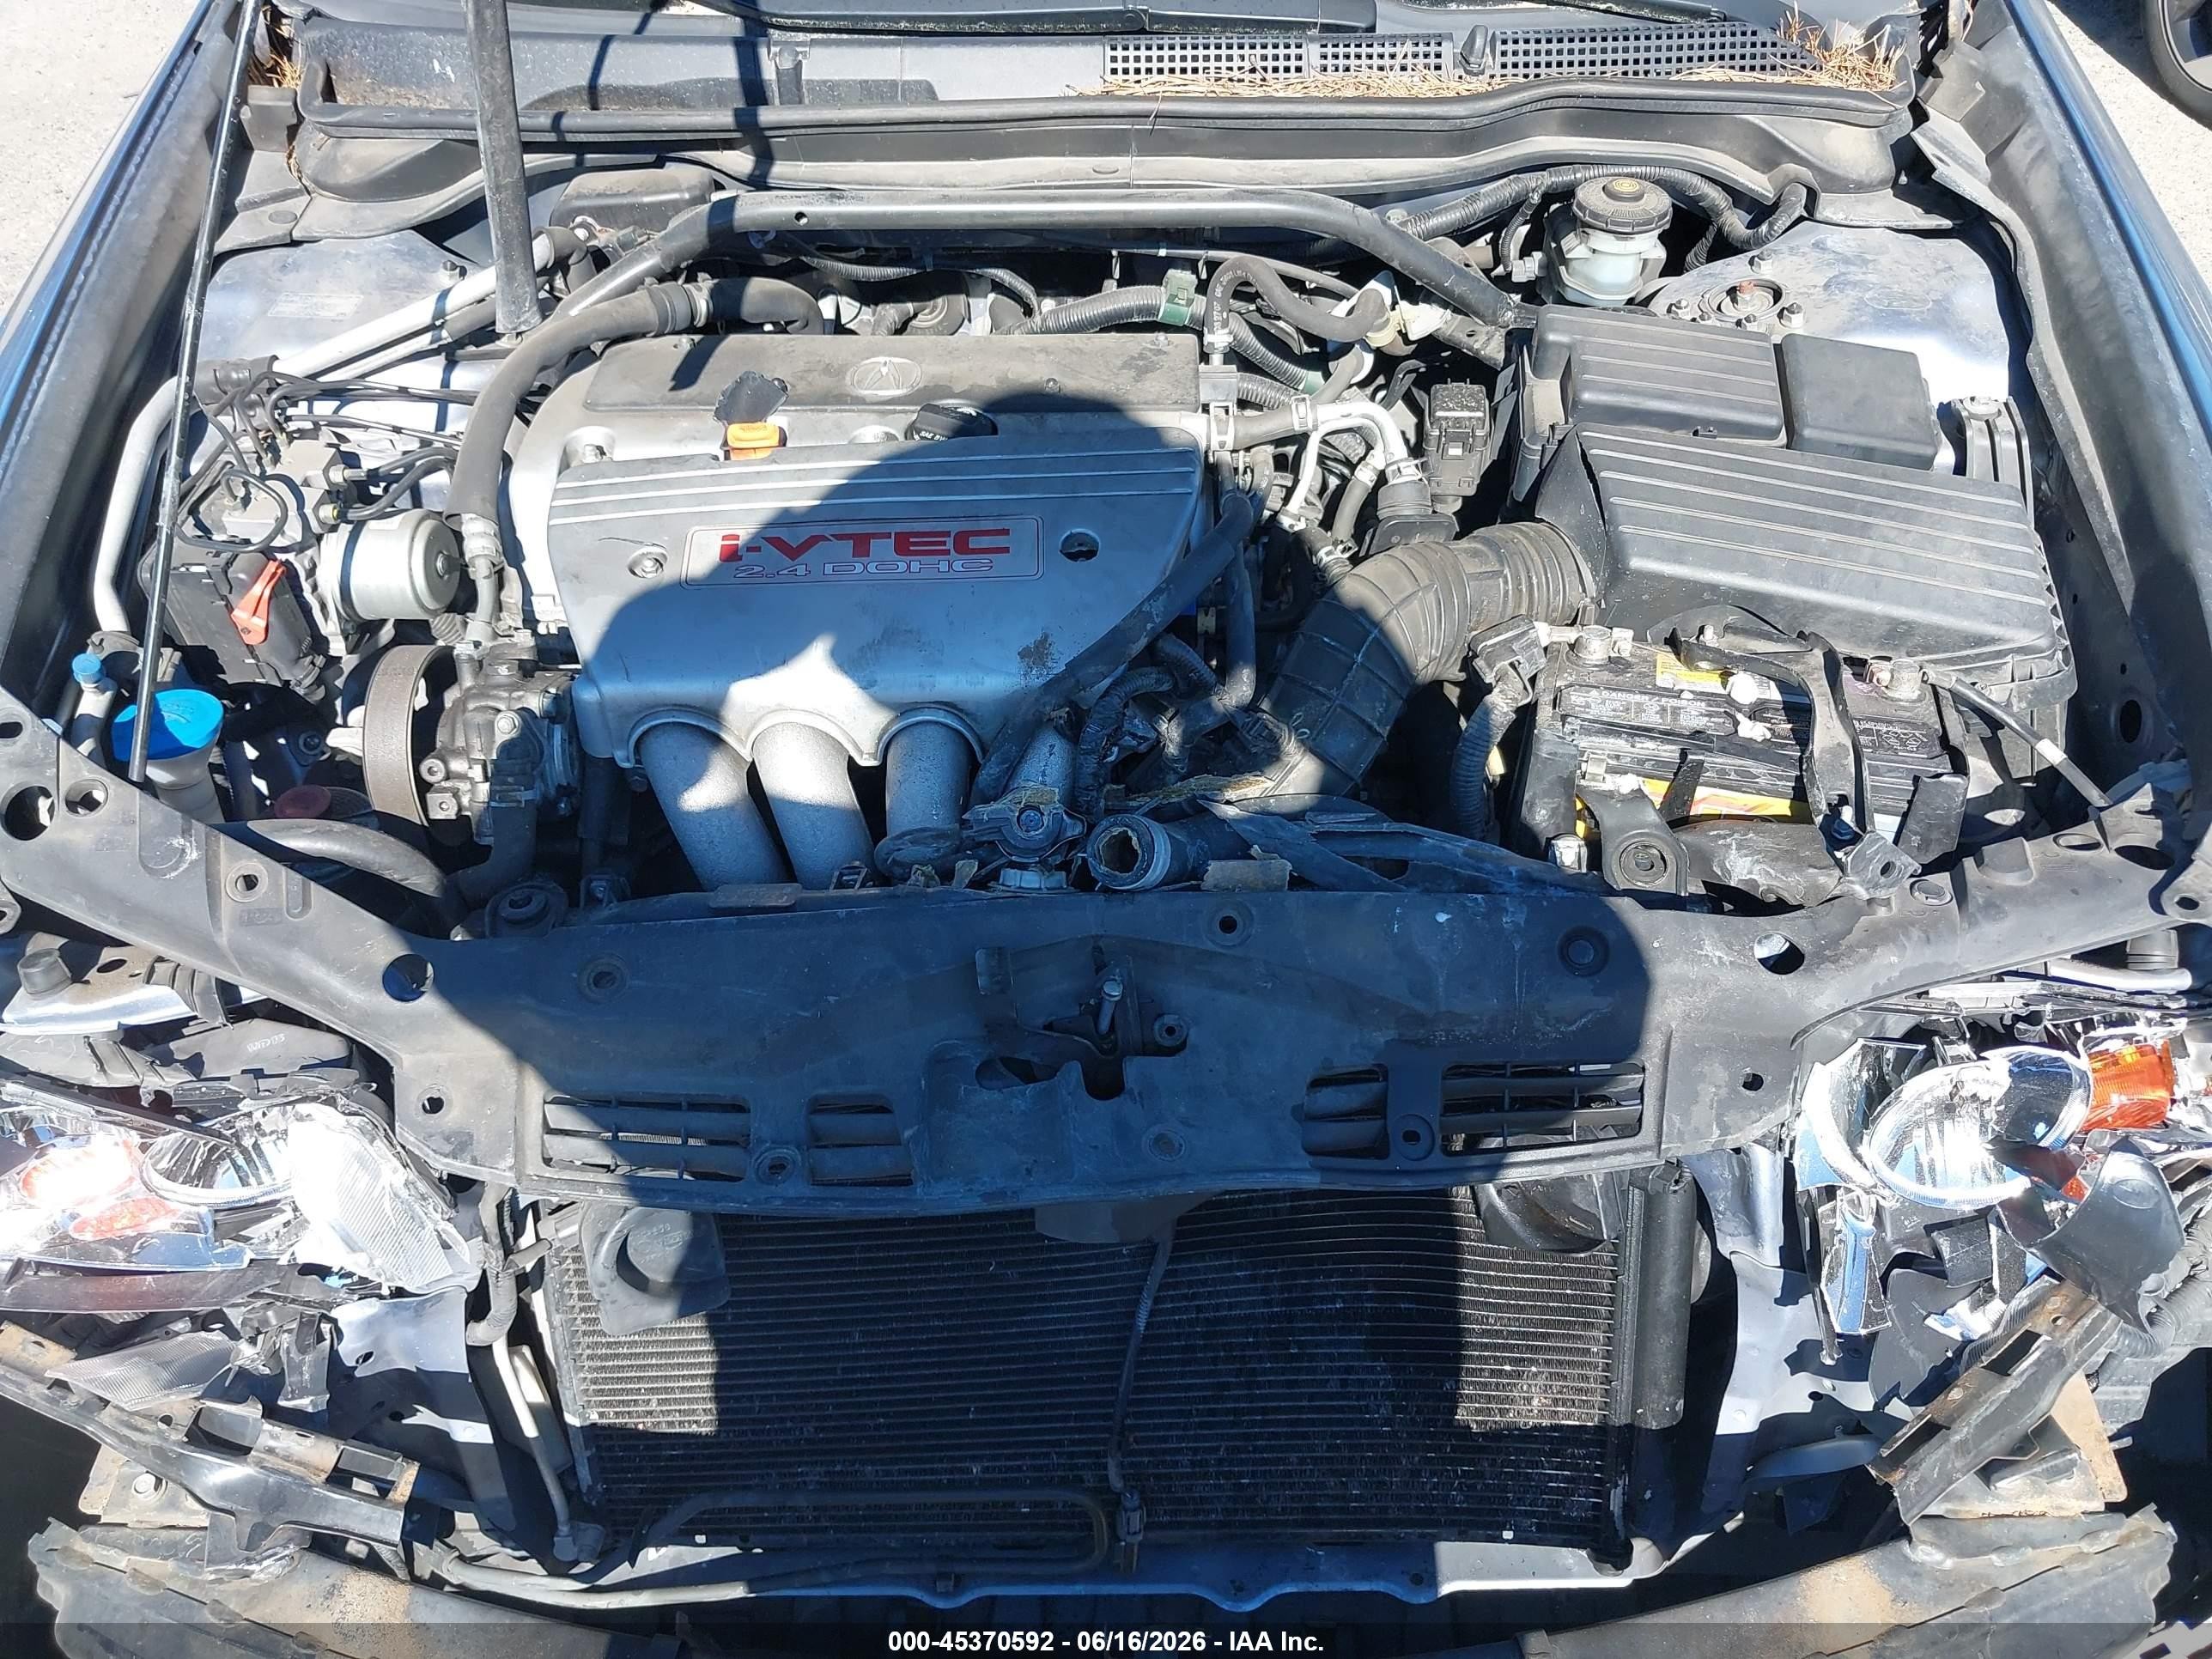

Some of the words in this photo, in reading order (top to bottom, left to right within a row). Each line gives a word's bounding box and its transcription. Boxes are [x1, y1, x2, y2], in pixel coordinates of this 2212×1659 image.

[719, 528, 1011, 562] i-VTEC
[733, 563, 811, 579] 2.4
[822, 558, 994, 577] DOHC
[1601, 690, 1650, 702] DANGER
[1661, 697, 1705, 708] POISON
